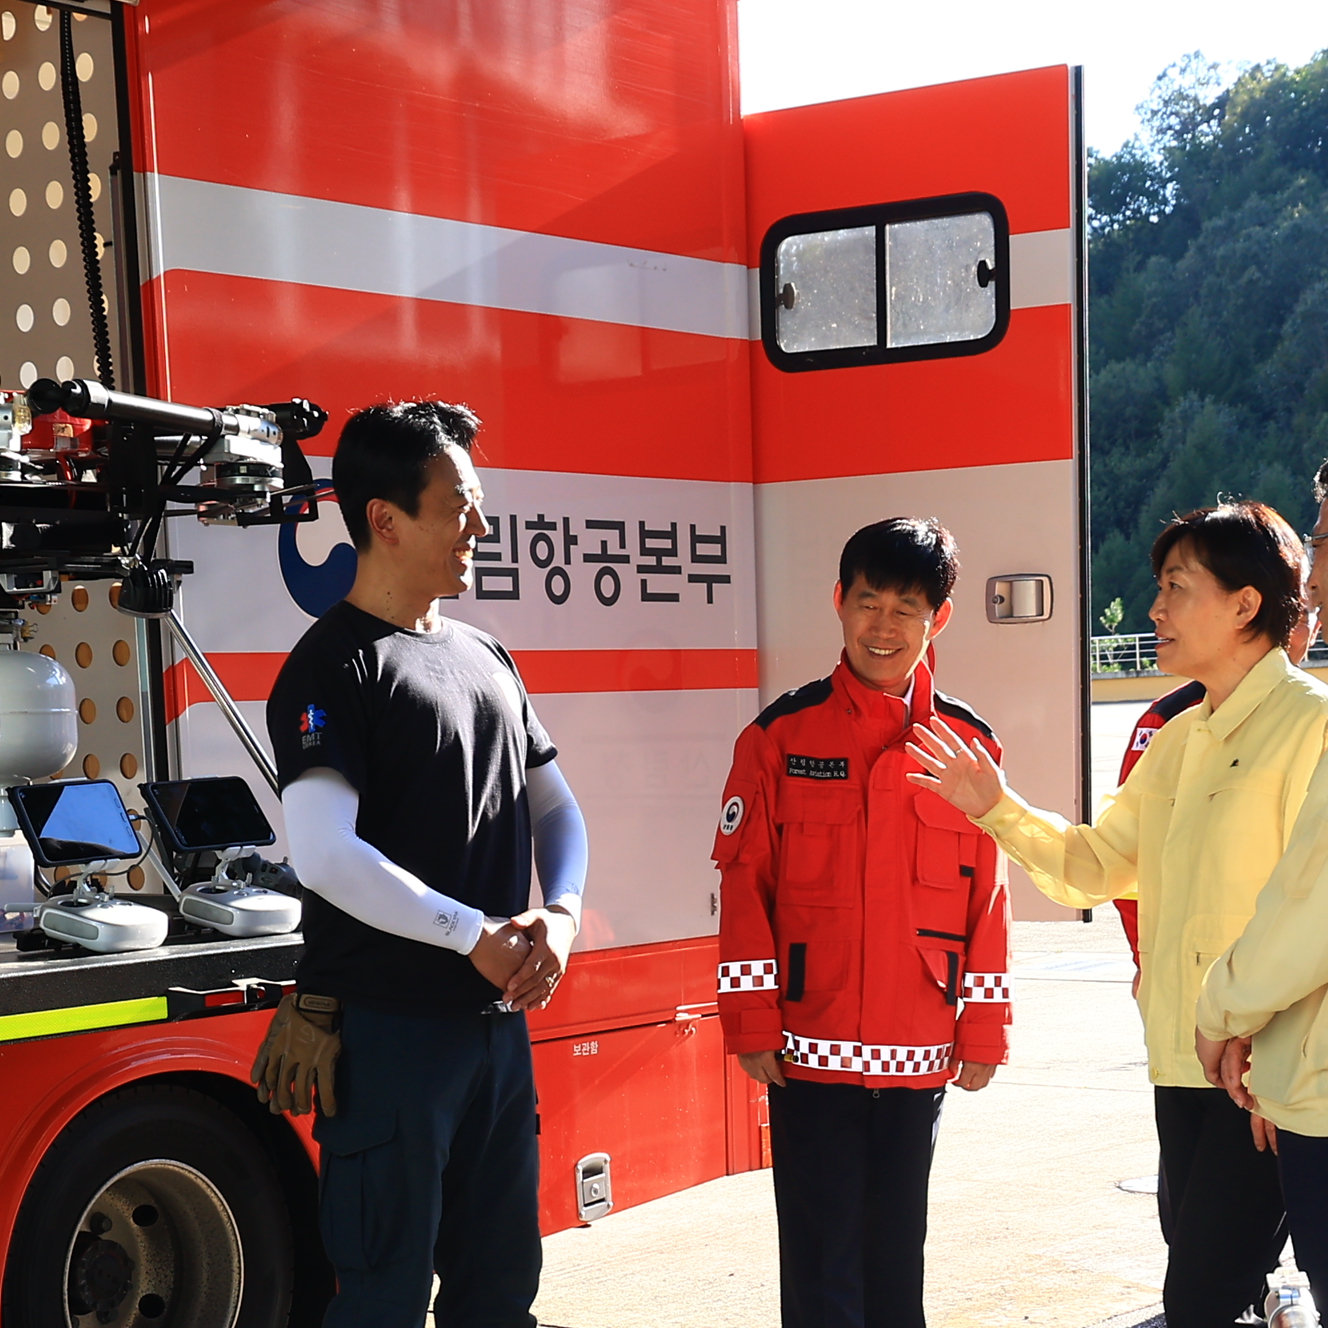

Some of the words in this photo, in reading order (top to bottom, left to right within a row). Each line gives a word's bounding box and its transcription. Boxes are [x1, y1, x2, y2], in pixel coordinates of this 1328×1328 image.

[440, 513, 731, 607] 림항공본부
[302, 732, 322, 742] EMT
[573, 1040, 599, 1056] 보관함
